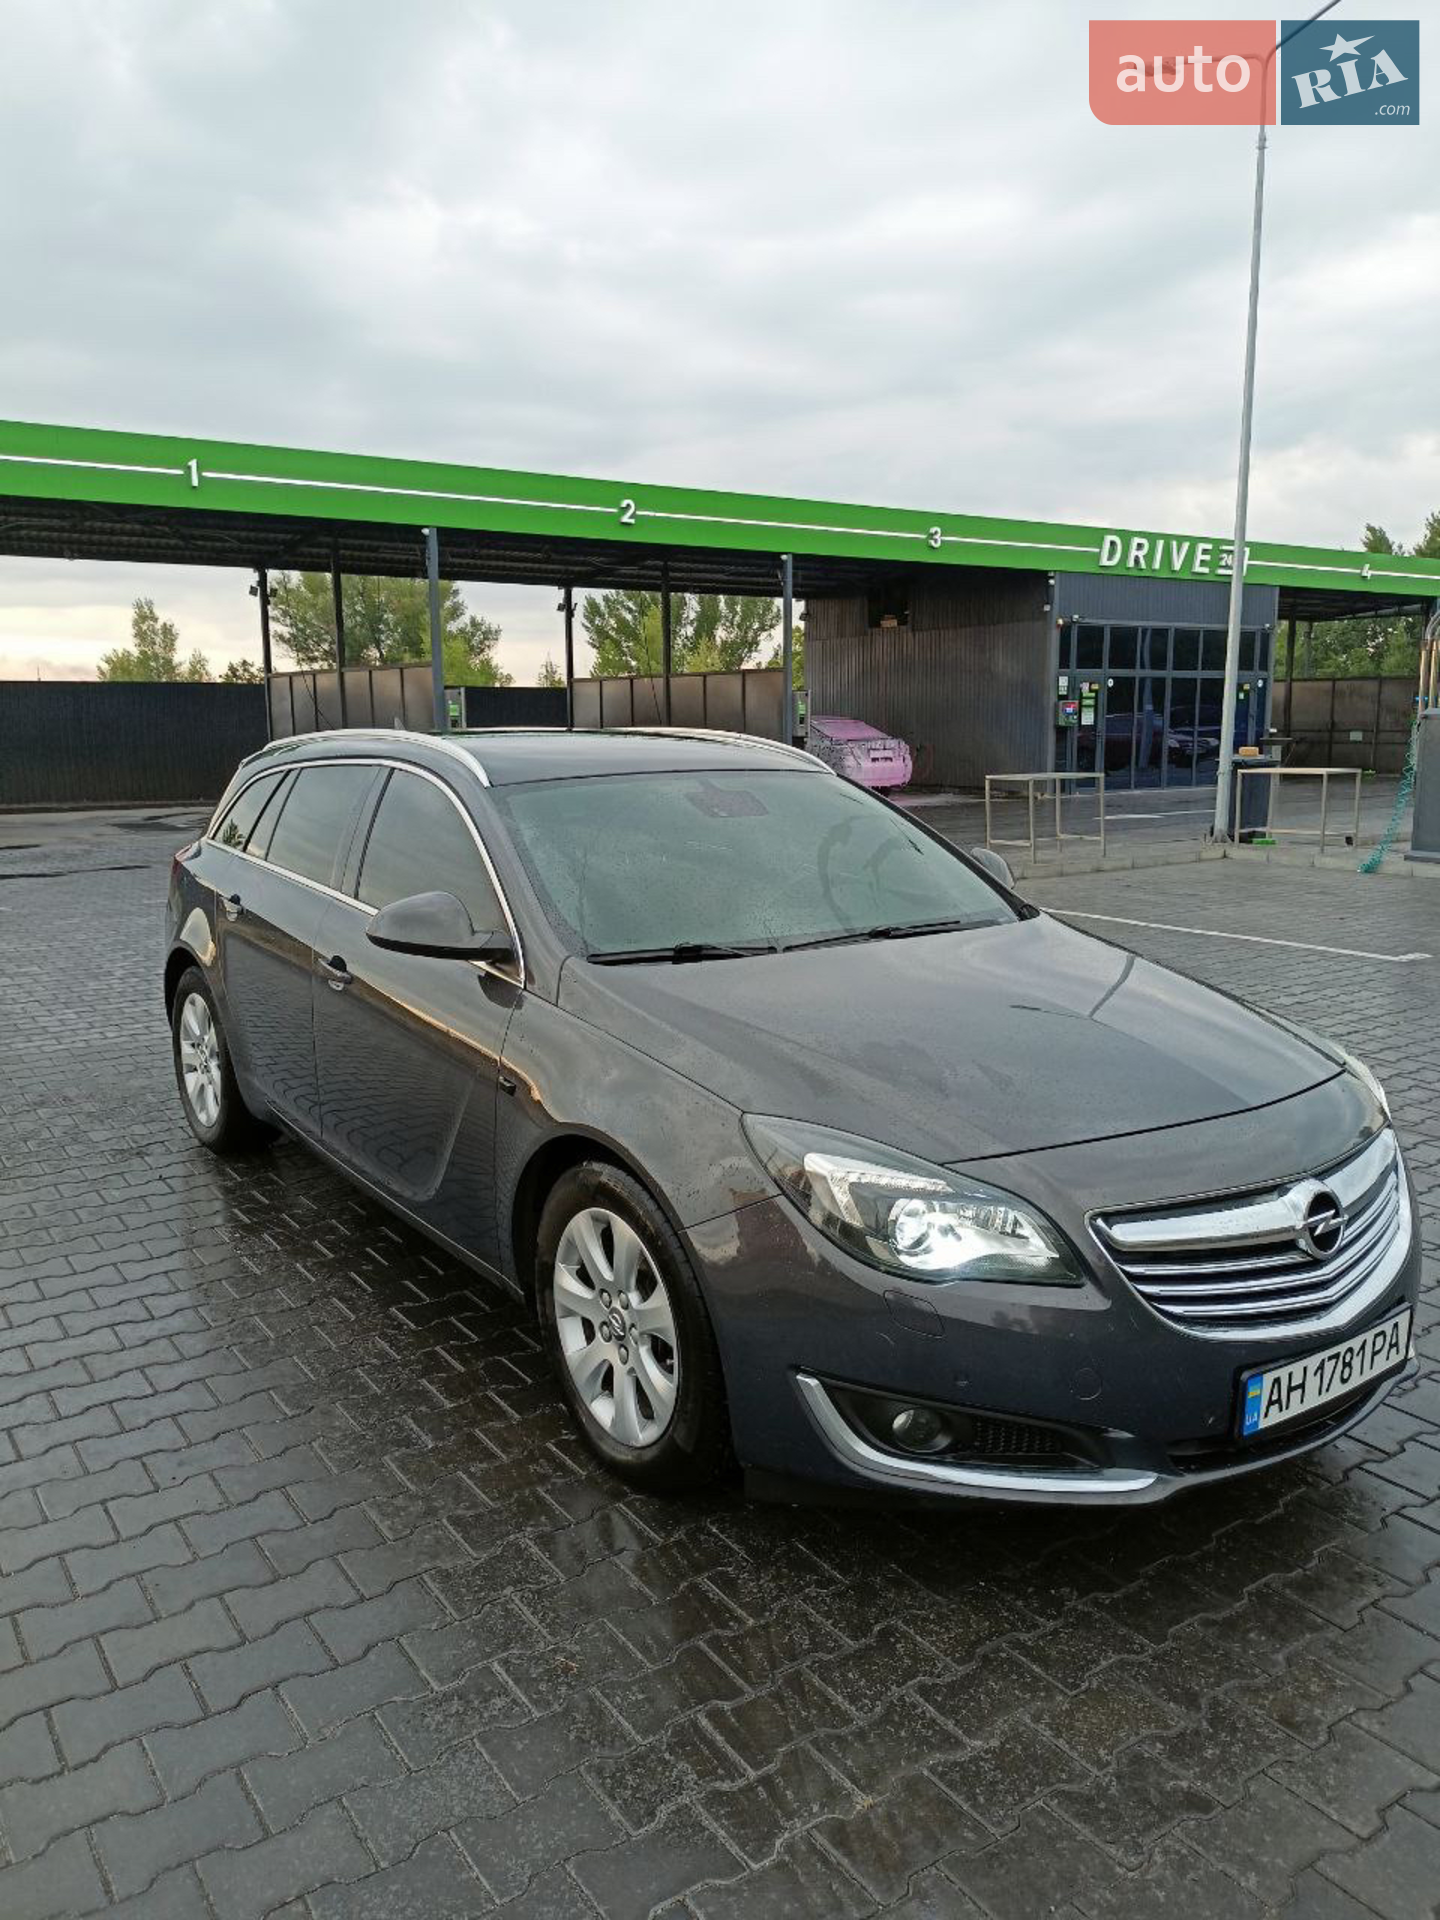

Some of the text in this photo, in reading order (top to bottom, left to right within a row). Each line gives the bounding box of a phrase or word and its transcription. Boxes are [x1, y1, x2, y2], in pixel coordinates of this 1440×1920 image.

[187, 458, 199, 487] 1
[620, 499, 636, 524] 2
[929, 526, 942, 548] 3
[1099, 534, 1213, 574] DRIVE
[1361, 563, 1371, 580] 4
